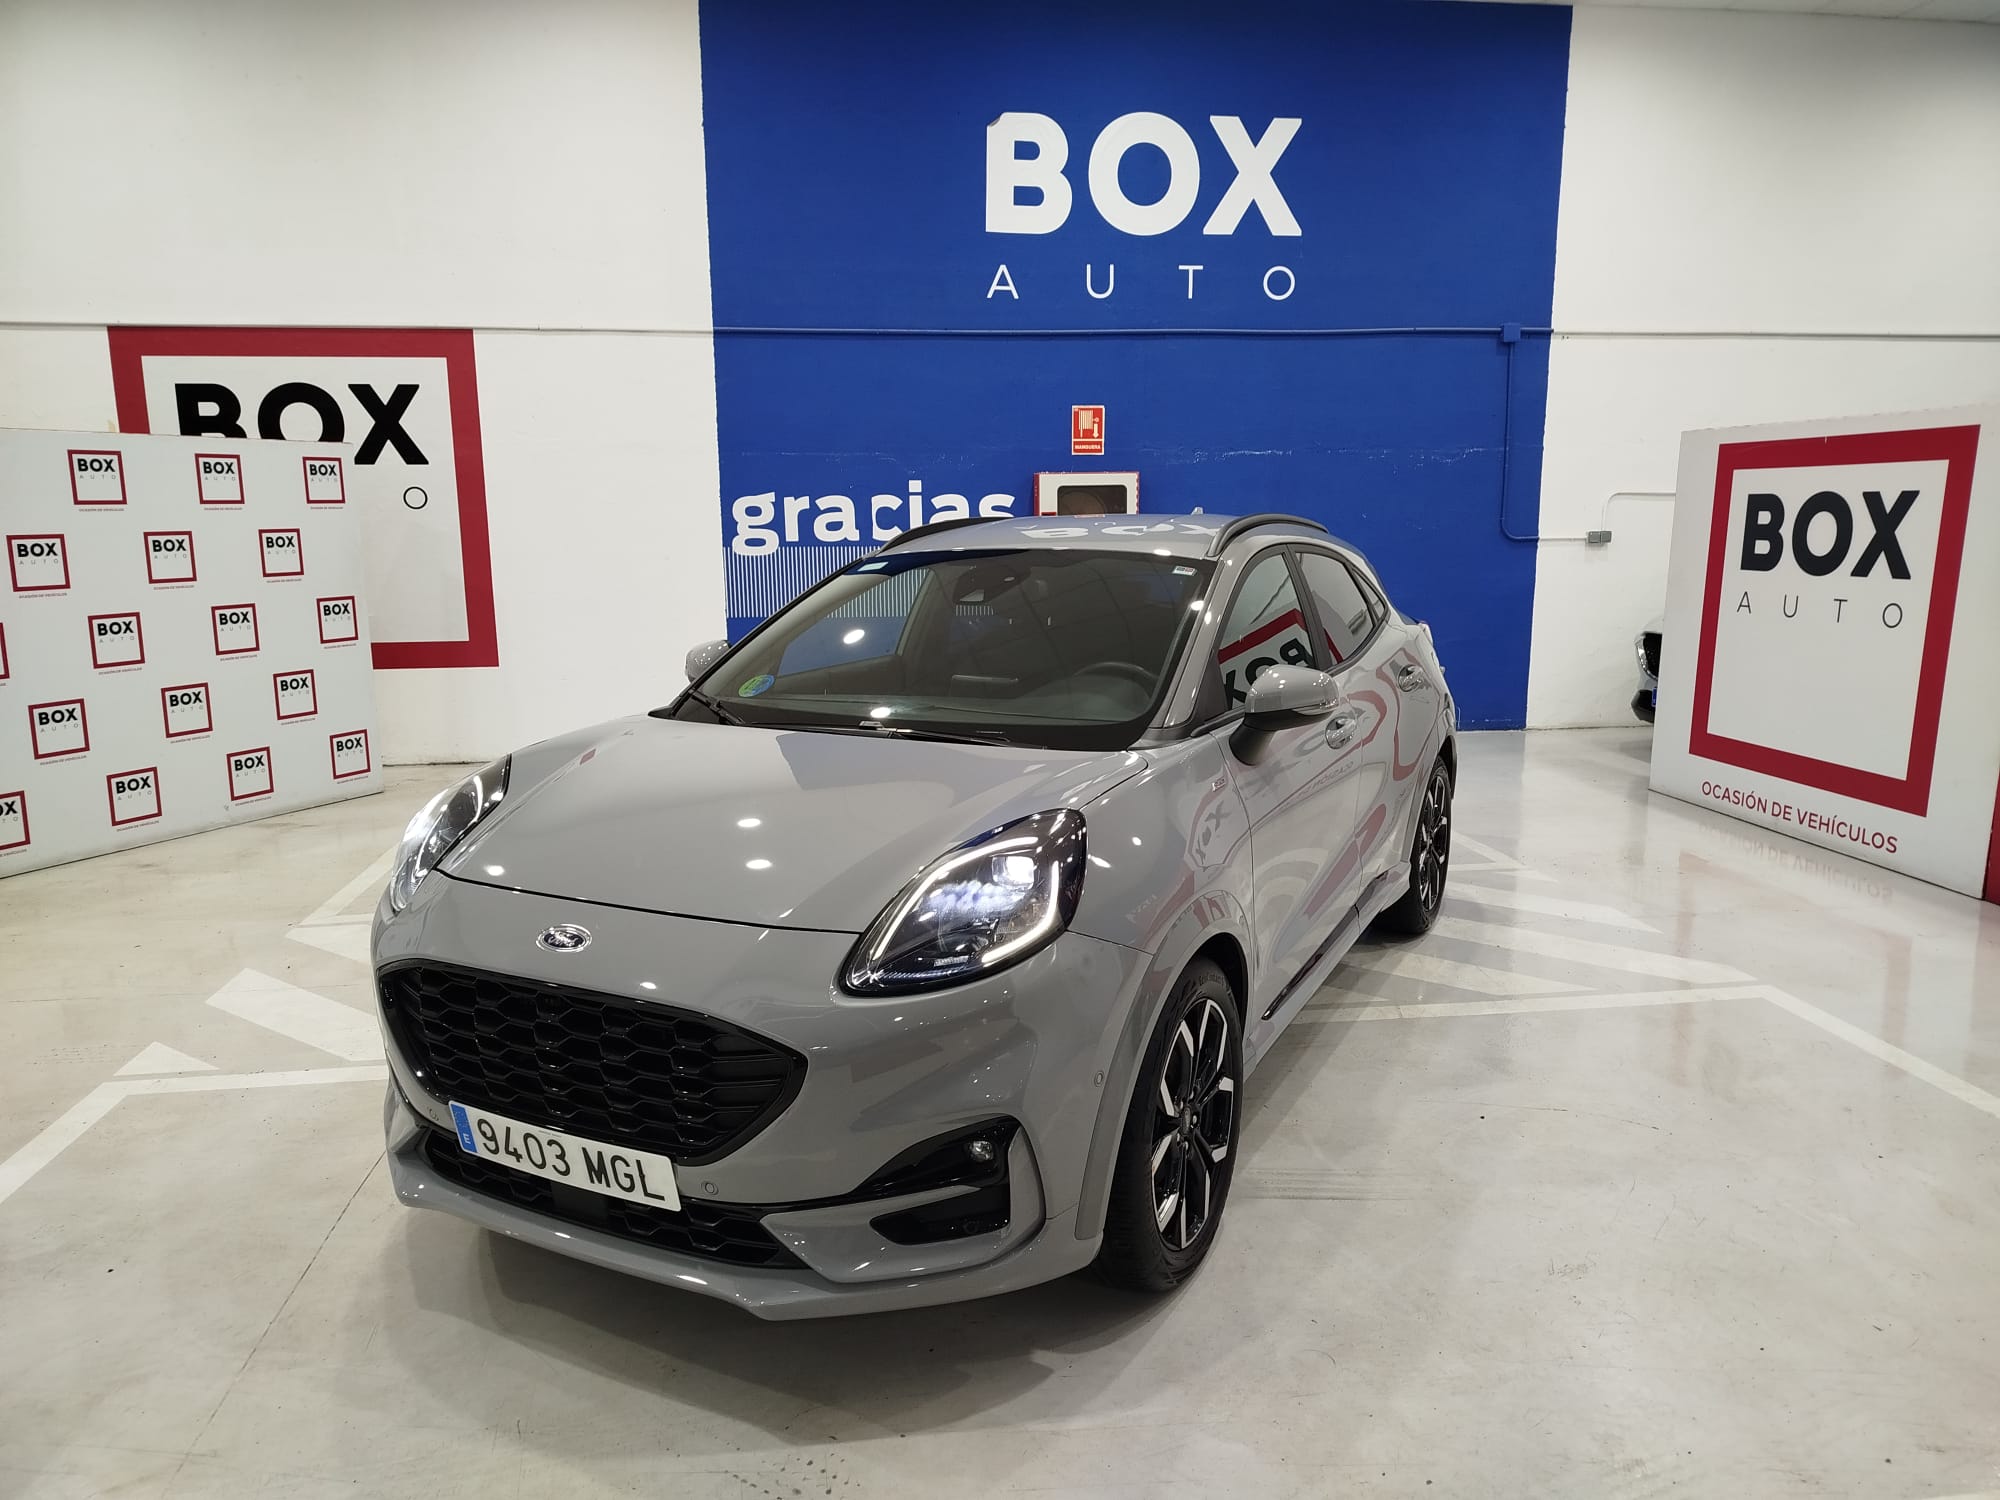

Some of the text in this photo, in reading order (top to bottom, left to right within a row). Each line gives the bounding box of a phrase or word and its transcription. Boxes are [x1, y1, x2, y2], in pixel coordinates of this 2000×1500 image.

[985, 111, 1302, 236] BOX
[986, 264, 1296, 301] AUTO
[174, 382, 429, 465] BOX
[77, 458, 115, 472] BOX
[203, 462, 234, 474] BOX
[310, 464, 336, 476] BOX
[266, 536, 295, 548] BOX
[1740, 490, 1921, 580] BOX
[17, 543, 58, 557] BOX
[152, 539, 186, 552] BOX
[323, 603, 350, 616] BOX
[1736, 591, 1904, 629] AUTO
[219, 611, 250, 625] BOX
[97, 621, 134, 636] BOX
[280, 677, 309, 691] BOX
[170, 691, 202, 707] BOX
[38, 708, 77, 725] BOX
[336, 737, 362, 752] BOX
[234, 755, 264, 771] BOX
[116, 776, 151, 794] BOX
[1701, 780, 1898, 854] OCASIÓN DE VEHÍCULOS
[463, 1134, 472, 1145] E
[476, 1117, 666, 1201] 9403 MGL
